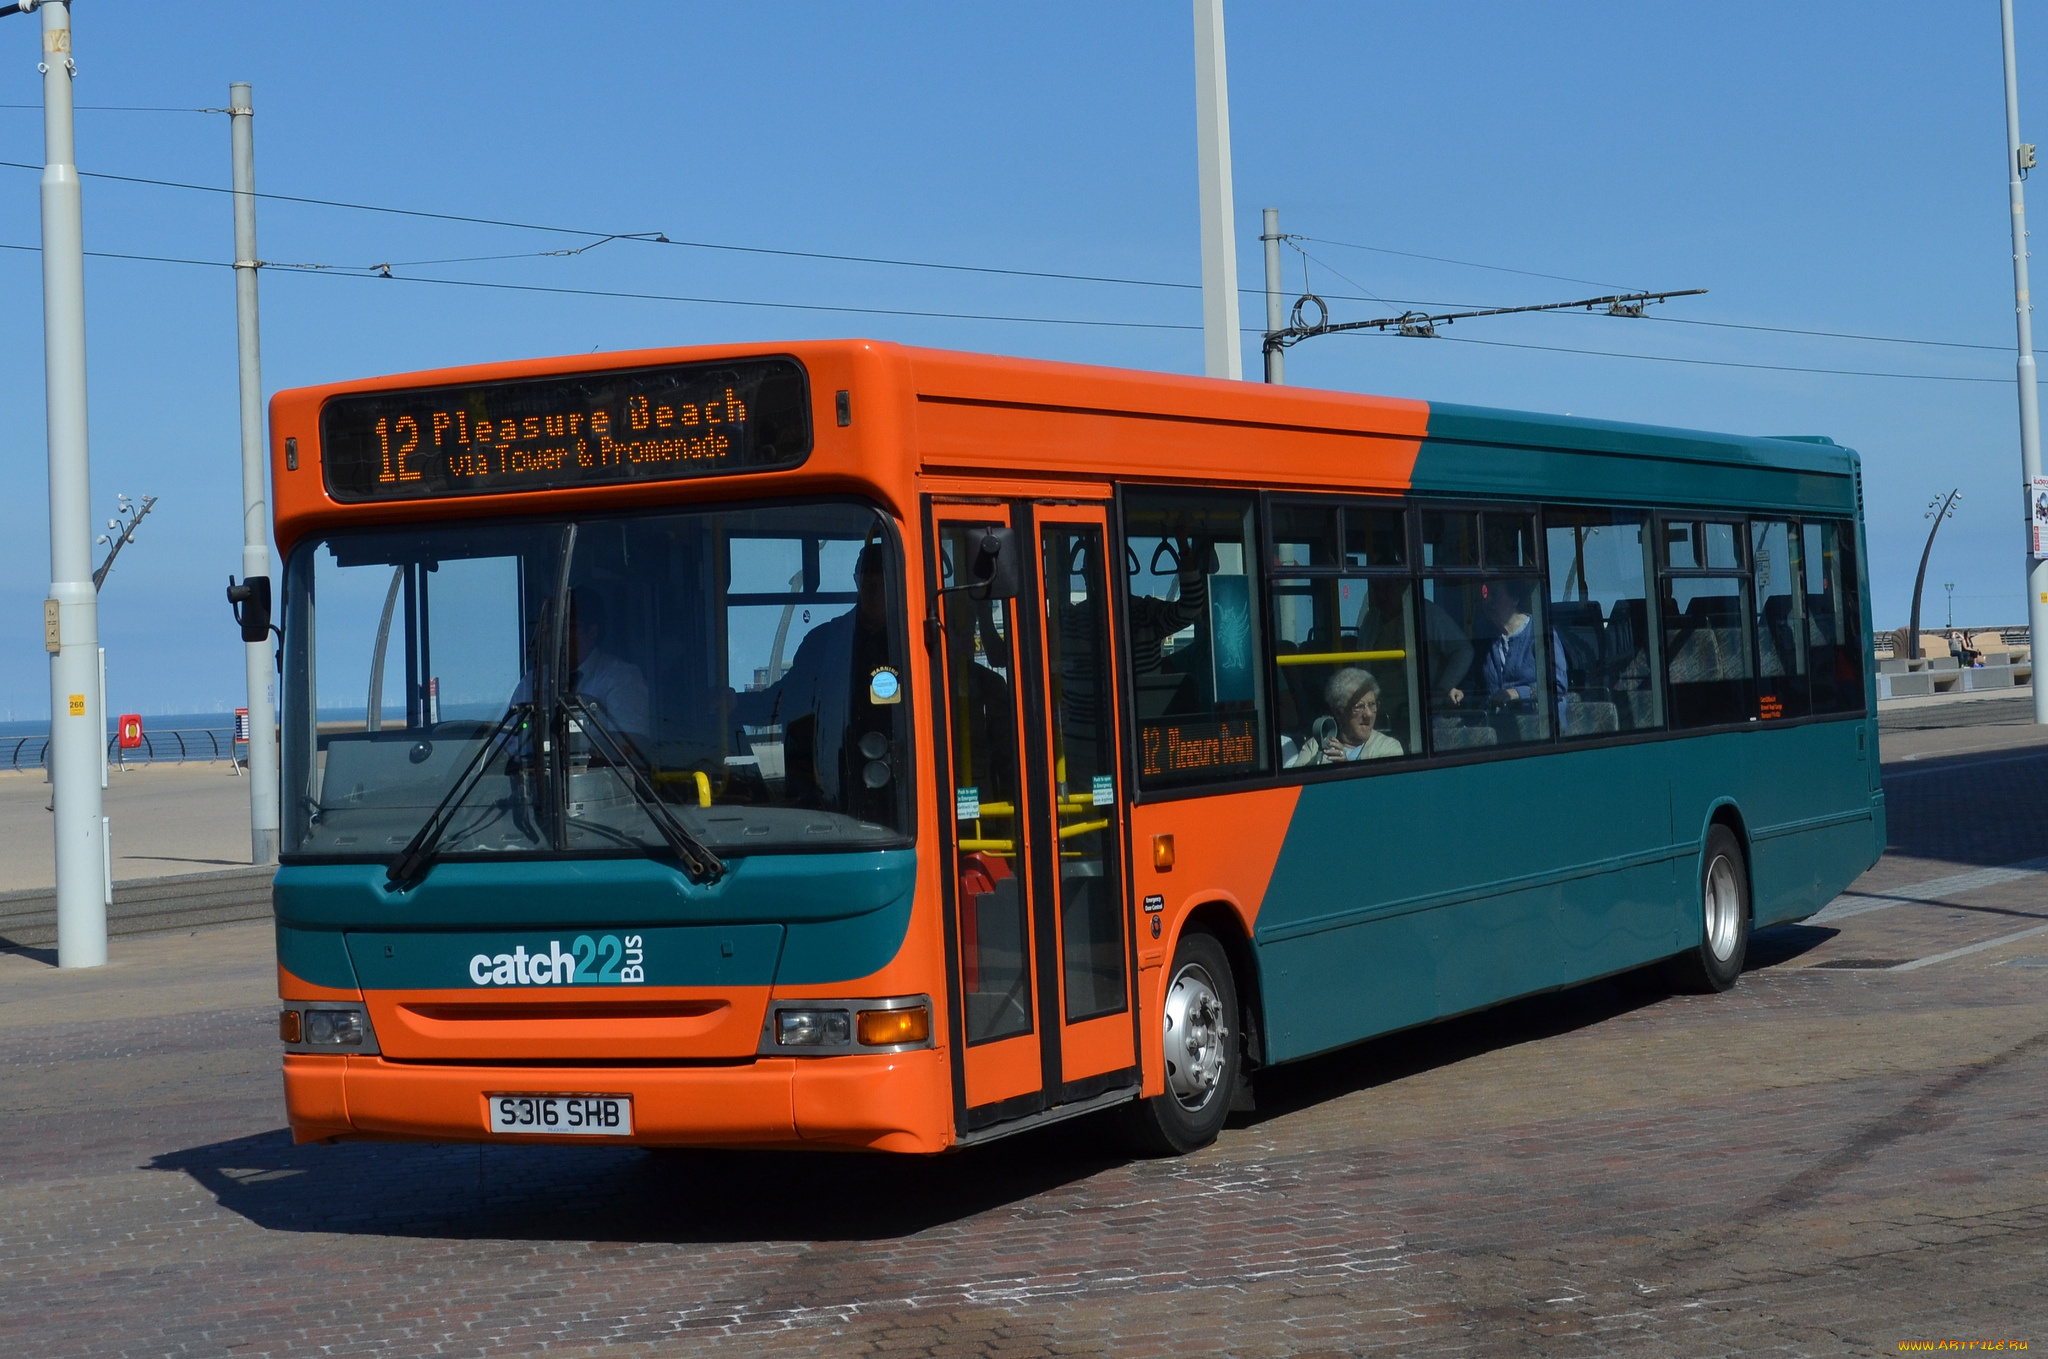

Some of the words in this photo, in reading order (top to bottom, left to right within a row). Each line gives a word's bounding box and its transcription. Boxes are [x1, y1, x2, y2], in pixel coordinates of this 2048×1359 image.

[375, 415, 421, 482] 12
[433, 410, 609, 446] Pleasure
[629, 388, 746, 430] Beach
[449, 447, 489, 476] via
[495, 443, 568, 473] Tower
[577, 438, 593, 467] &
[601, 428, 729, 465] Promenade
[69, 701, 84, 709] 260
[1143, 726, 1161, 775] 12
[1168, 727, 1220, 770] Pleasure
[1221, 722, 1253, 763] Beach
[500, 1099, 559, 1126] S316
[567, 1100, 620, 1127] SHB
